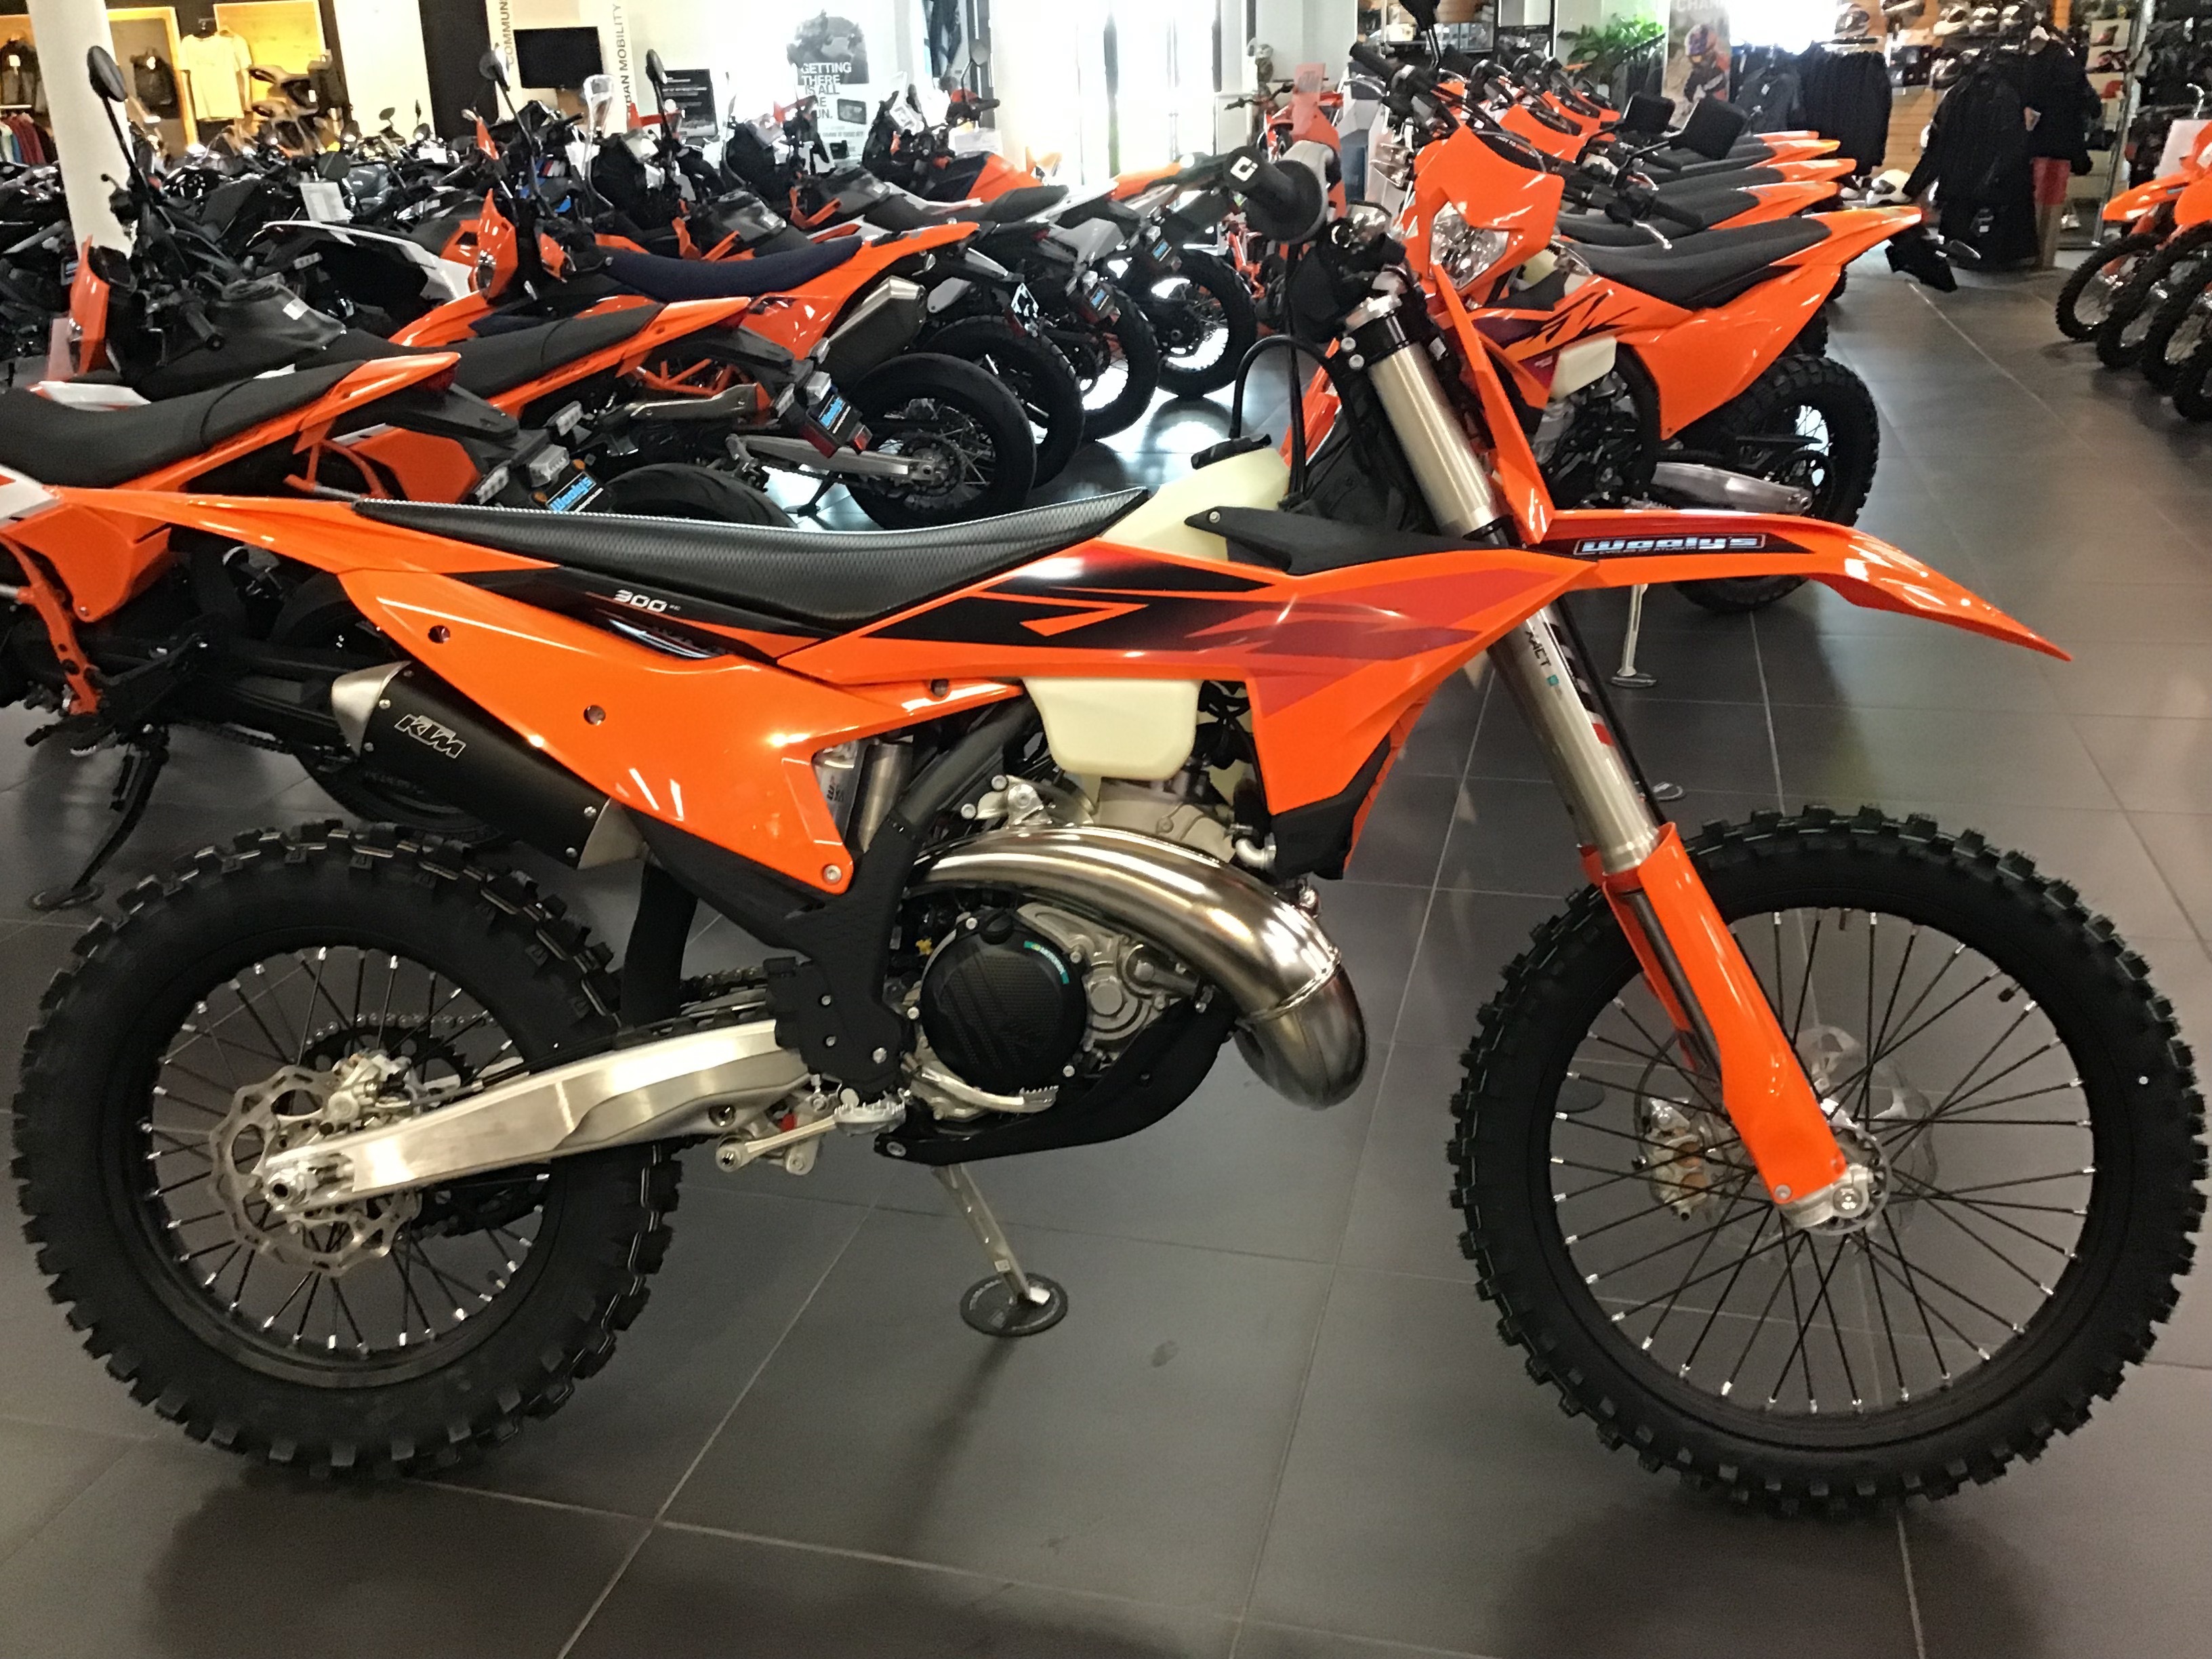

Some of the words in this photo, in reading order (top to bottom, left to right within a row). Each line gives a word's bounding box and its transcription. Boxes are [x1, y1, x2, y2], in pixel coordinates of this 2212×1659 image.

[613, 4, 628, 71] MOBILITY
[801, 62, 852, 73] GETTING
[801, 75, 840, 85] THERE
[805, 85, 816, 95] IS
[819, 85, 840, 95] ALL
[613, 589, 668, 613] 300
[394, 714, 466, 758] KTM
